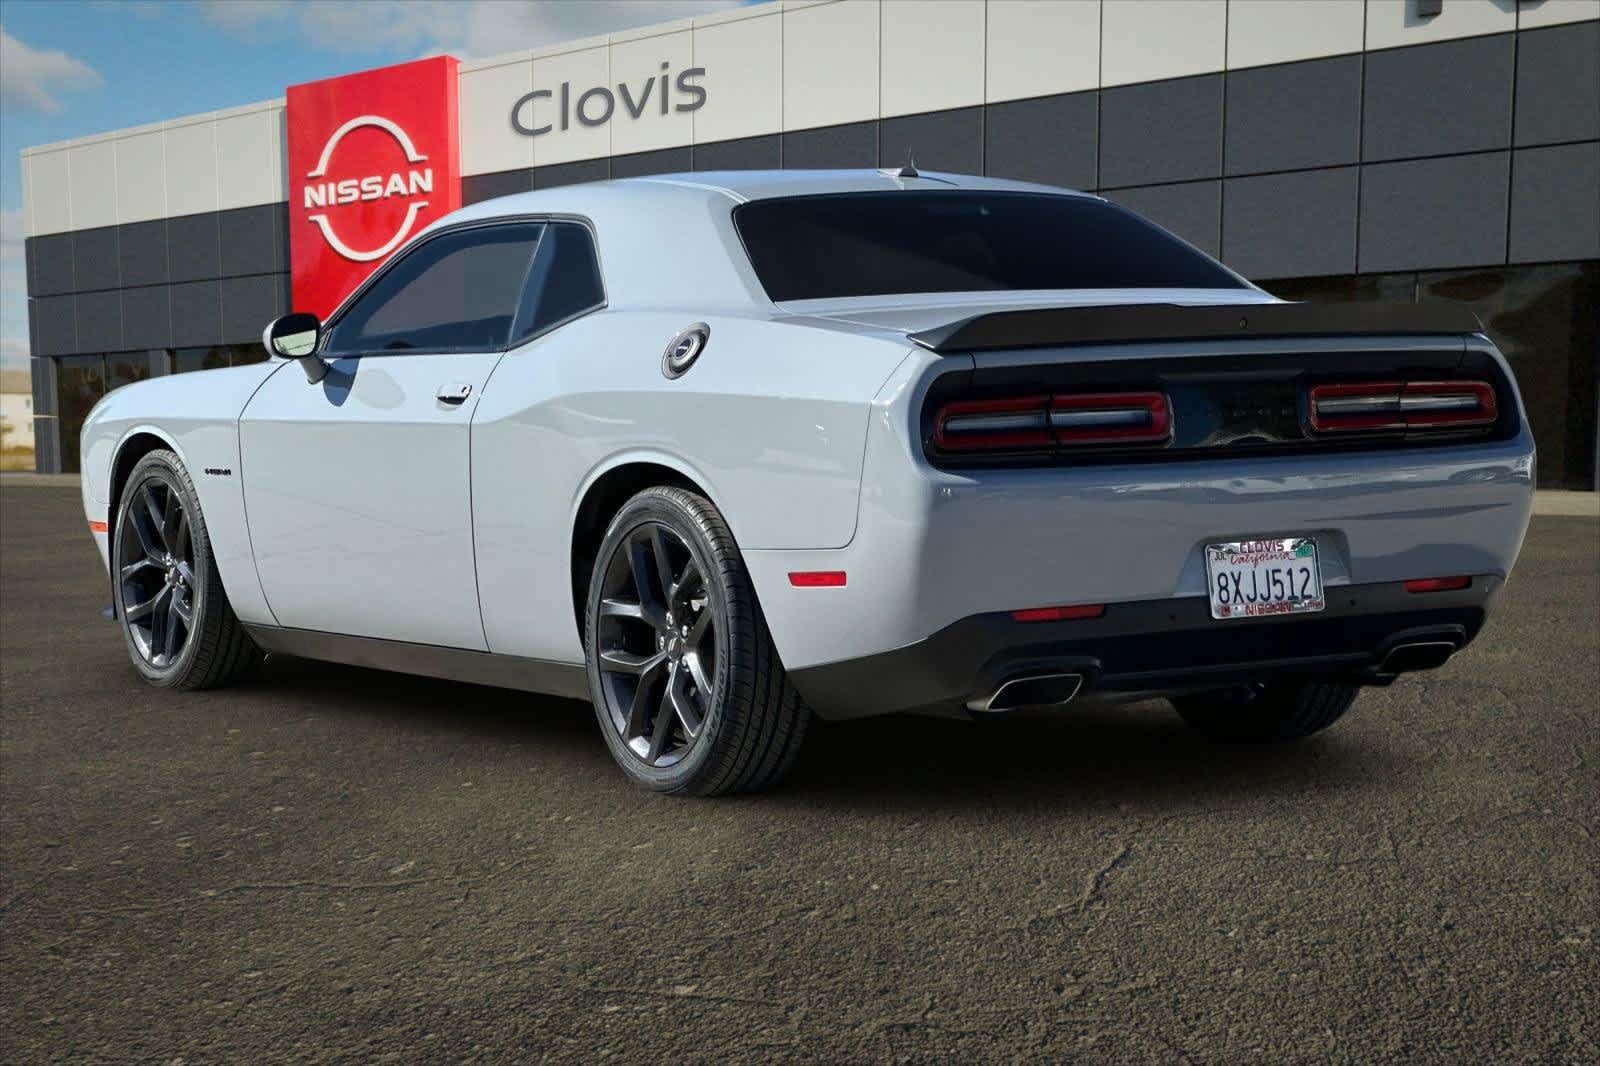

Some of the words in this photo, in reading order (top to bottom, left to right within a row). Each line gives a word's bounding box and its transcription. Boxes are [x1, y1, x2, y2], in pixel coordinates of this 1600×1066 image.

[510, 62, 708, 137] Clovis
[304, 168, 434, 208] NISSAN
[1240, 539, 1285, 554] CLOVIS
[1217, 567, 1313, 604] 8XJJ512
